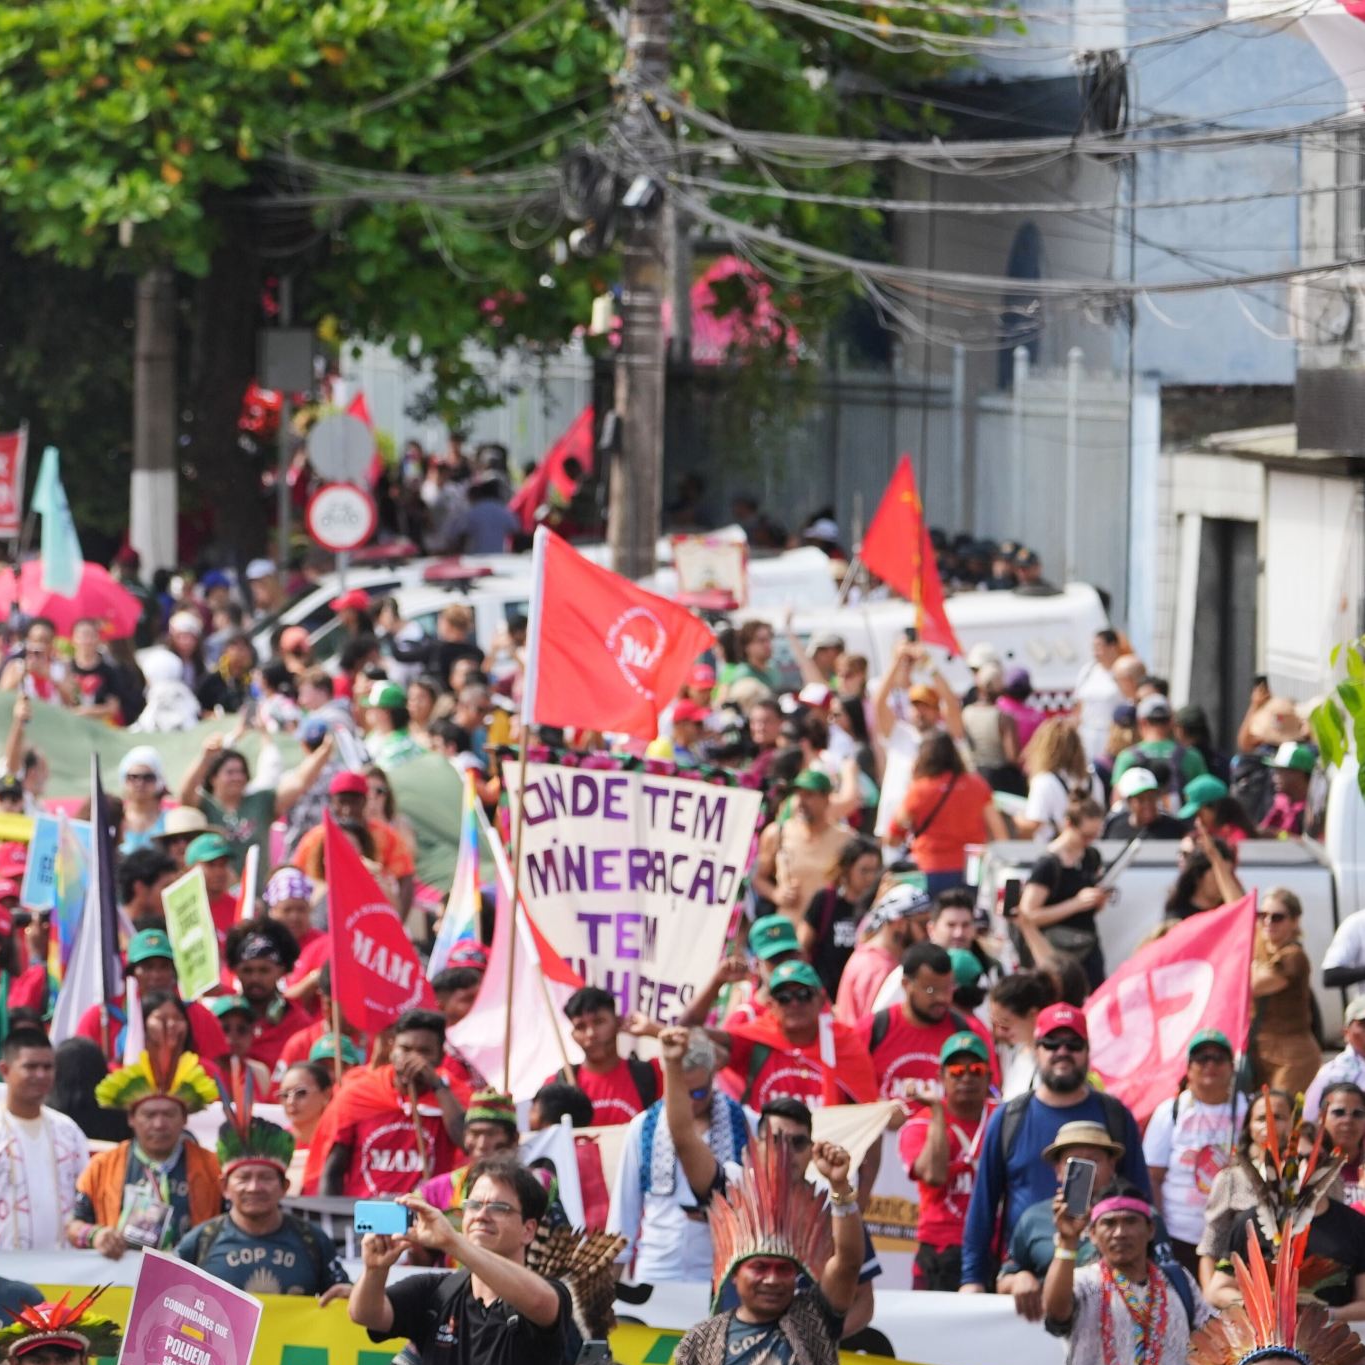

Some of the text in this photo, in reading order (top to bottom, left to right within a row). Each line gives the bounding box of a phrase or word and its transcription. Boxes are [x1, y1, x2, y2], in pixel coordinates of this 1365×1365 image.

[521, 773, 728, 843] ONDE TEM
[353, 928, 414, 990] MAM
[577, 911, 658, 963] TEM
[371, 1149, 424, 1173] MAM
[225, 1247, 297, 1268] COP 30
[162, 1296, 229, 1340] COMUNIDADES QUE
[194, 1297, 205, 1313] AS
